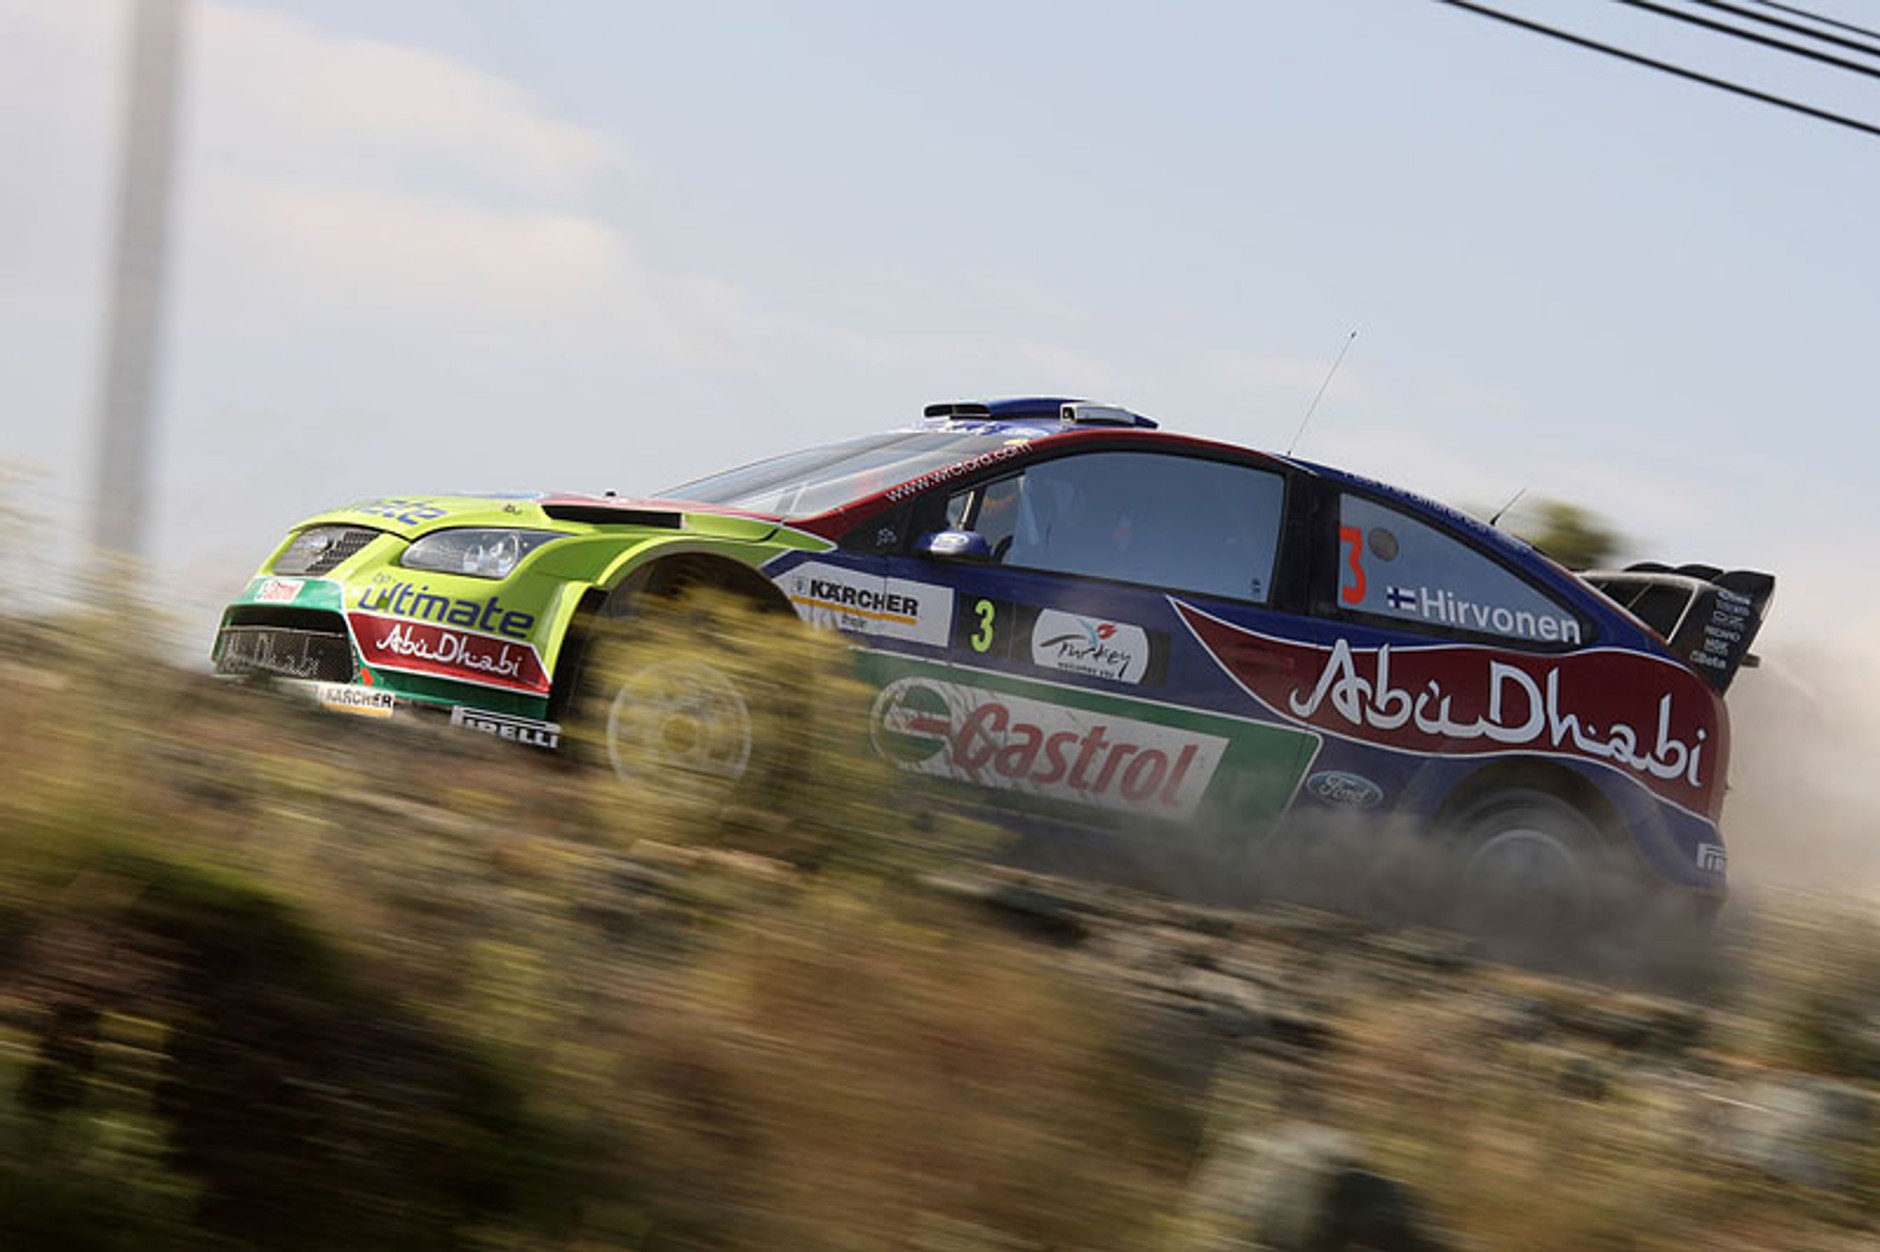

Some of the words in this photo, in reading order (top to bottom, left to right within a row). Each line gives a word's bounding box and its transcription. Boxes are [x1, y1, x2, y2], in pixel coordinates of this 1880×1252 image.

[1340, 525, 1367, 604] 3
[358, 583, 535, 638] ultimate
[970, 599, 995, 652] 3
[1420, 586, 1581, 645] Hirvonen
[451, 704, 562, 748] PIRELLI
[951, 701, 1200, 808] Castrol
